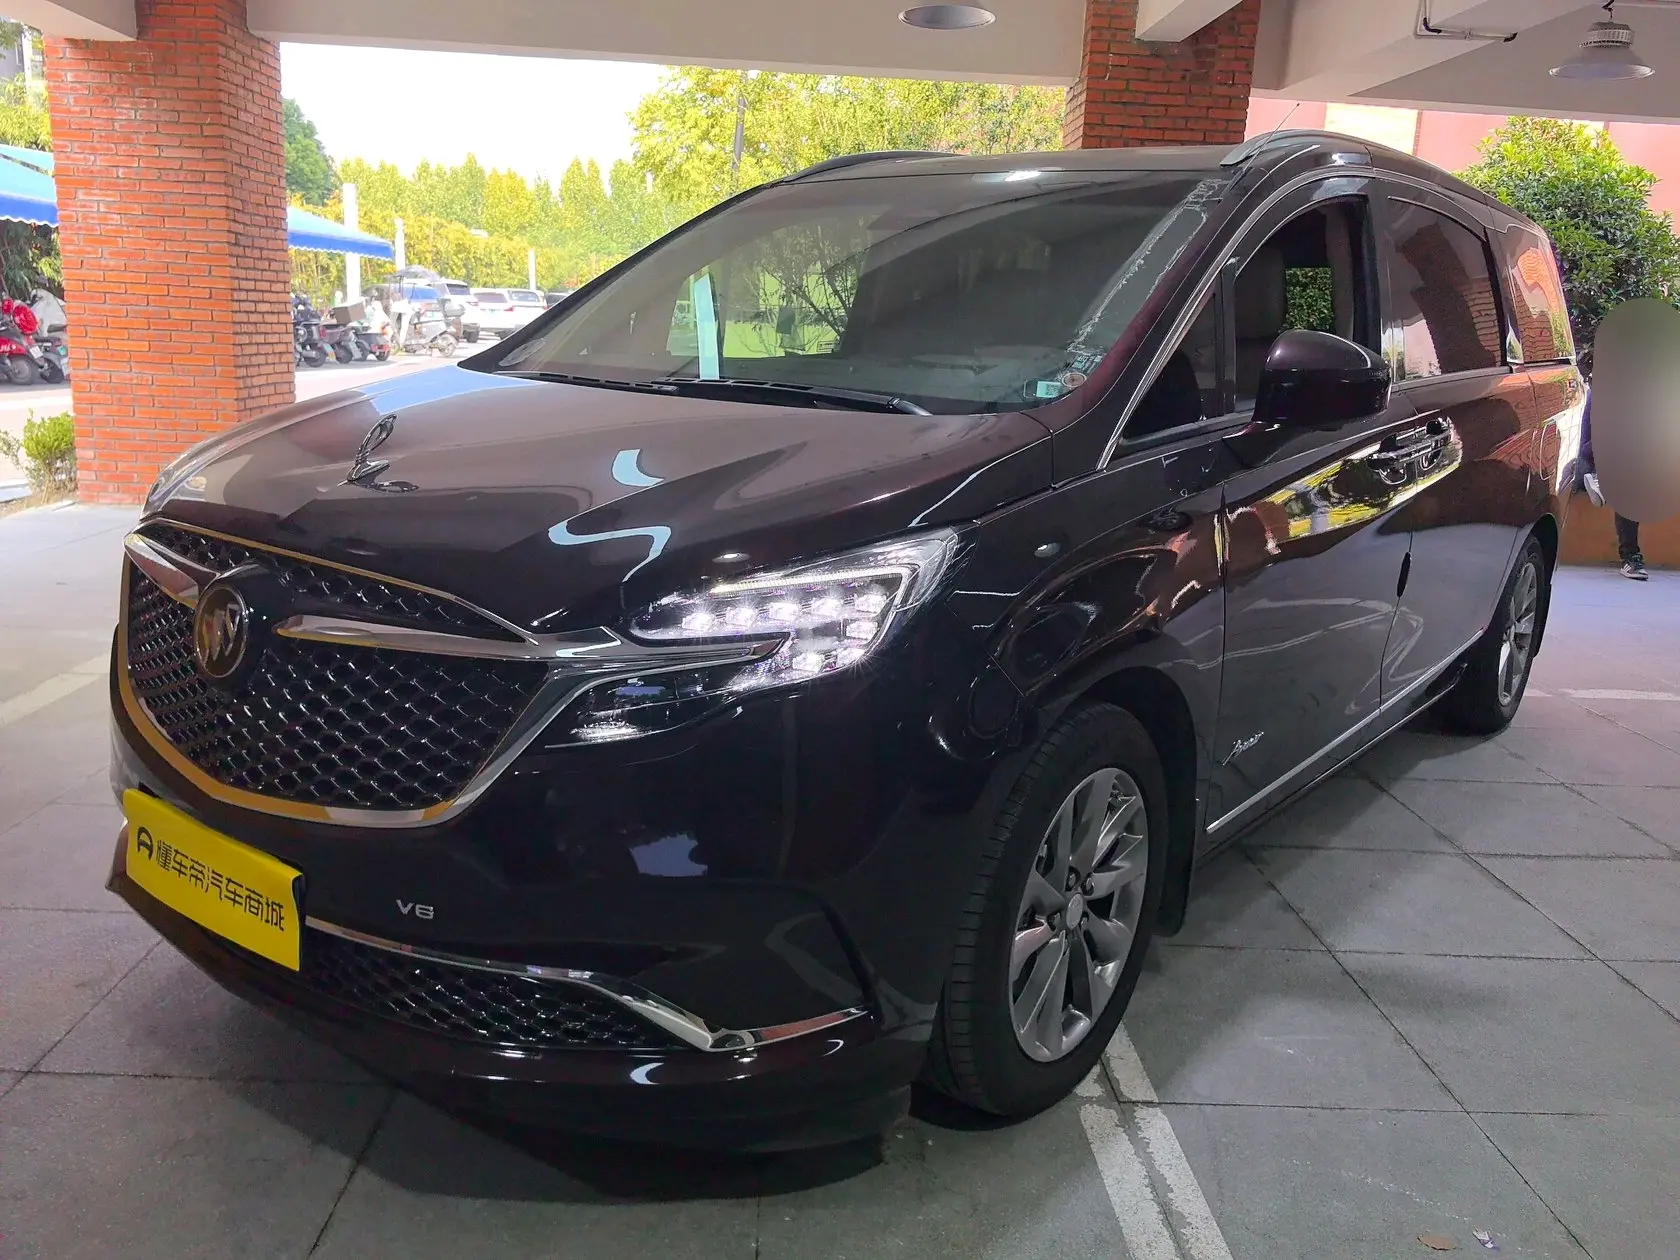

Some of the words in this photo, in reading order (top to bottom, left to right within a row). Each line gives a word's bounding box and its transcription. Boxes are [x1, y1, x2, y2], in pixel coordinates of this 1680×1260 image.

[156, 839, 285, 932] 懂车帝汽车商城
[396, 899, 434, 919] V6
